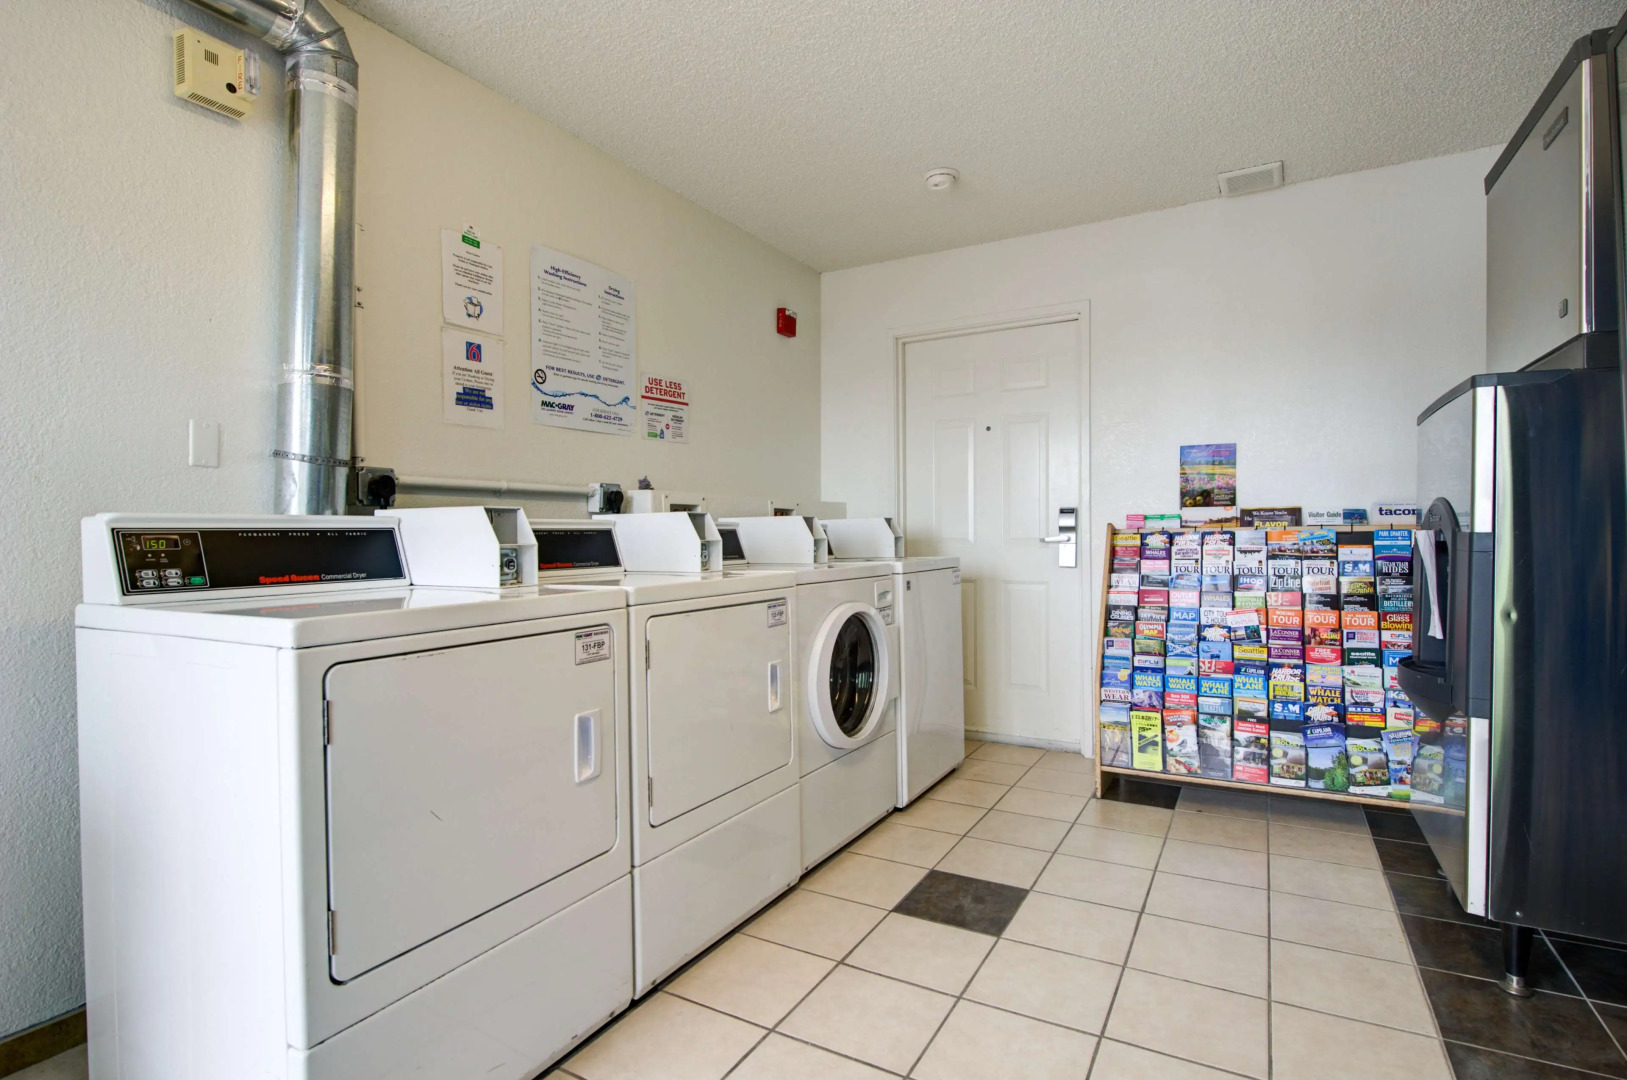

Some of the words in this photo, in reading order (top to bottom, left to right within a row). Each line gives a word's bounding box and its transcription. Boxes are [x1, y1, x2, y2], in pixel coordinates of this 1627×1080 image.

[550, 265, 582, 280] High-Efficiency
[543, 269, 563, 281] Washing
[563, 275, 587, 287] Instructions
[568, 368, 587, 378] RESULTS,
[647, 376, 664, 387] USE
[665, 379, 682, 391] LESS
[644, 385, 686, 400] DETERGENT
[146, 540, 166, 549] 150
[1204, 566, 1230, 574] TOUR
[1236, 567, 1264, 575] TOUR
[1272, 566, 1299, 575] TOUR
[1307, 566, 1335, 575] TOUR
[259, 575, 290, 585] Speed
[290, 574, 320, 583] Queen
[321, 572, 352, 581] Commercial
[353, 571, 367, 579] Dryer
[1271, 576, 1301, 589] ZipLine
[1173, 612, 1195, 620] MAP
[1273, 616, 1299, 624] TOUR
[1309, 615, 1336, 624] TOUR
[1387, 614, 1409, 622] Glass
[1345, 617, 1375, 626] TOUR
[582, 640, 605, 651] 131-FBP
[1271, 674, 1300, 682] CRUISE
[1234, 682, 1263, 690] PLANE
[1104, 693, 1130, 701] WEAR
[1309, 689, 1341, 697] WHALE
